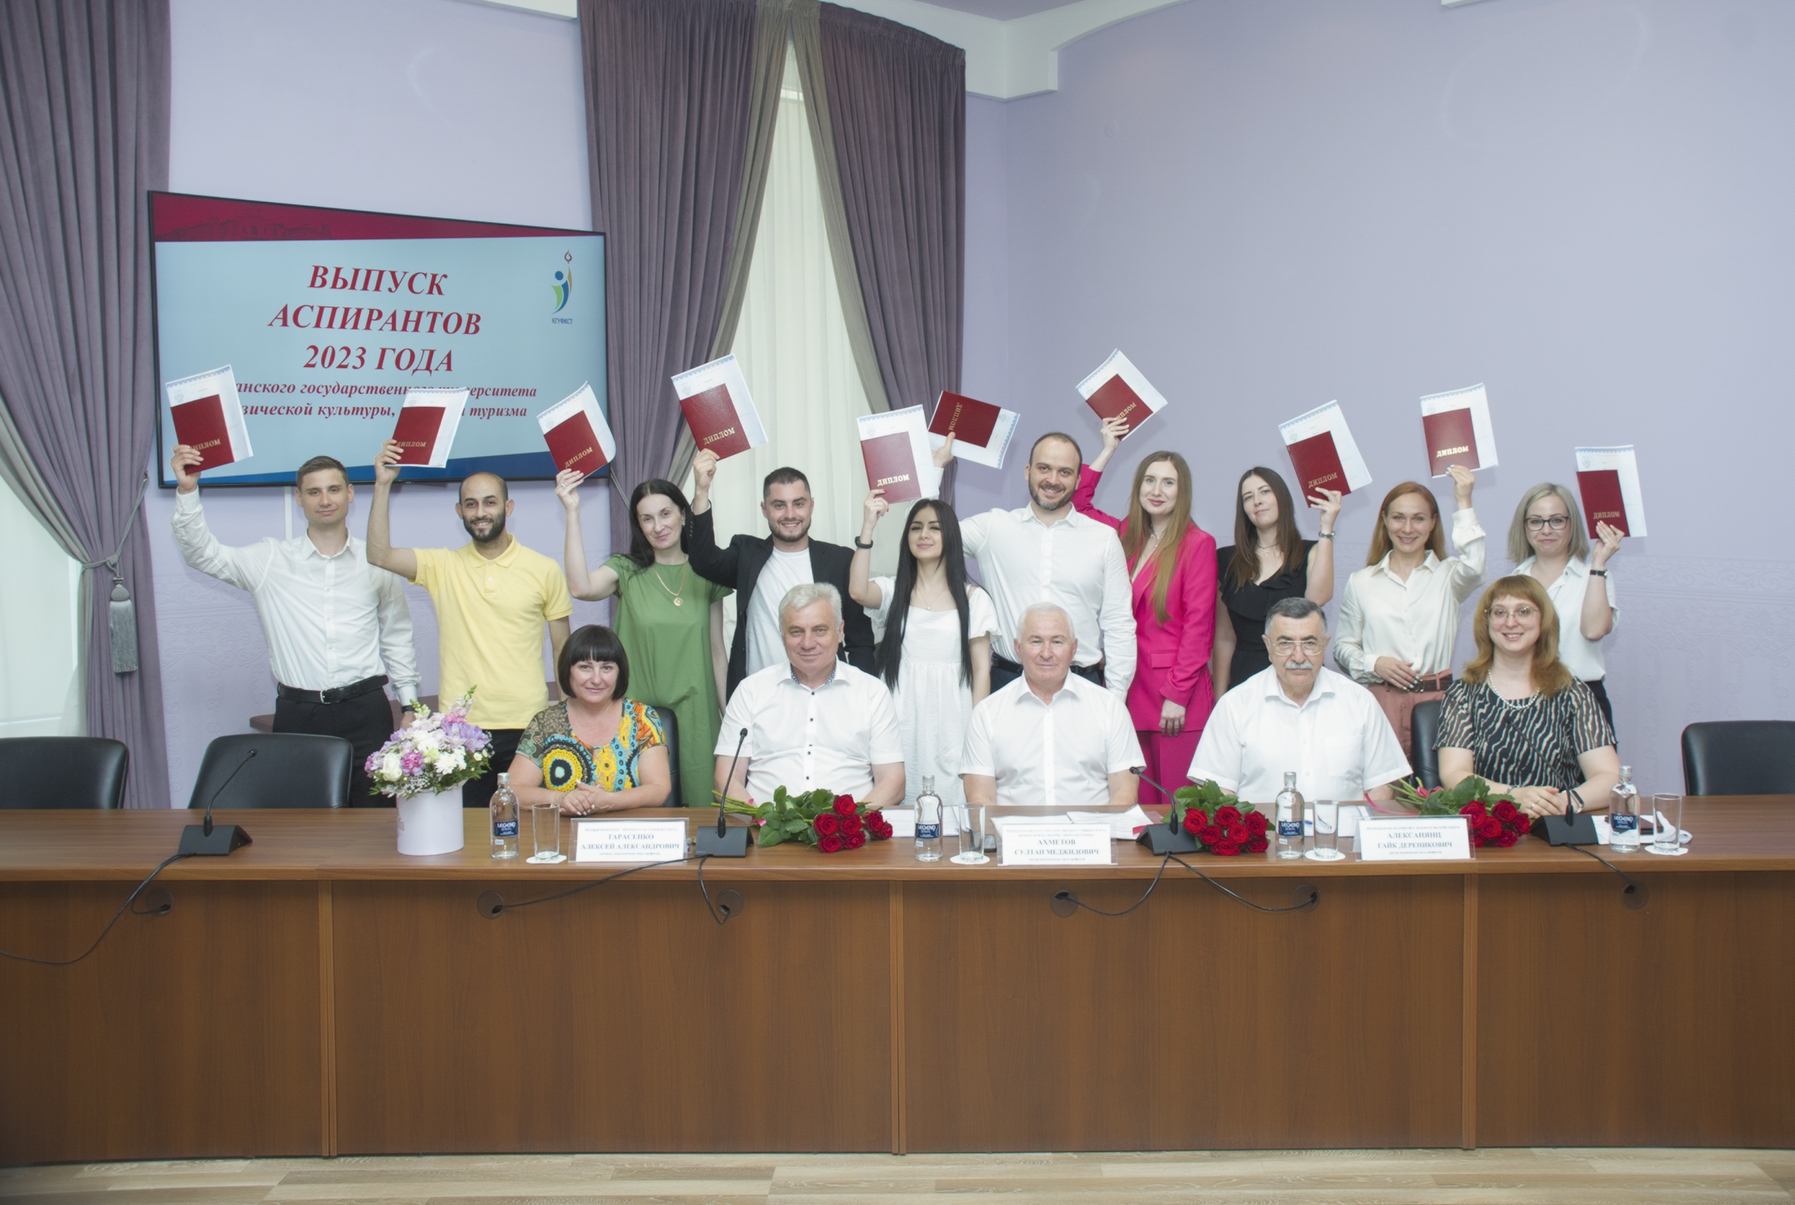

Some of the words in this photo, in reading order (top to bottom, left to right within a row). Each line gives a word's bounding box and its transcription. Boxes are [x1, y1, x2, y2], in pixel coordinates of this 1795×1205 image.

[307, 264, 448, 296] ВЫПУСК
[267, 303, 482, 335] АСПИРАНТОВ
[303, 344, 367, 370] 2023
[374, 347, 453, 377] ГОДА
[235, 382, 296, 394] анского
[438, 386, 537, 399] ерситета
[242, 402, 313, 416] зической
[317, 404, 395, 420] культуры,
[469, 406, 528, 420] туризма
[948, 402, 963, 431] ДИПЛОМ
[1116, 402, 1137, 420] ИПЛОМ
[703, 427, 736, 445] ДИПЛОМ
[564, 446, 593, 469] ДИПЛОМ
[1436, 445, 1469, 458] ДИПЛОМ
[877, 473, 910, 487] ДИПЛОМ
[1308, 472, 1338, 488] ДИПЛОМ
[1593, 511, 1620, 520] ДИПЛОМ
